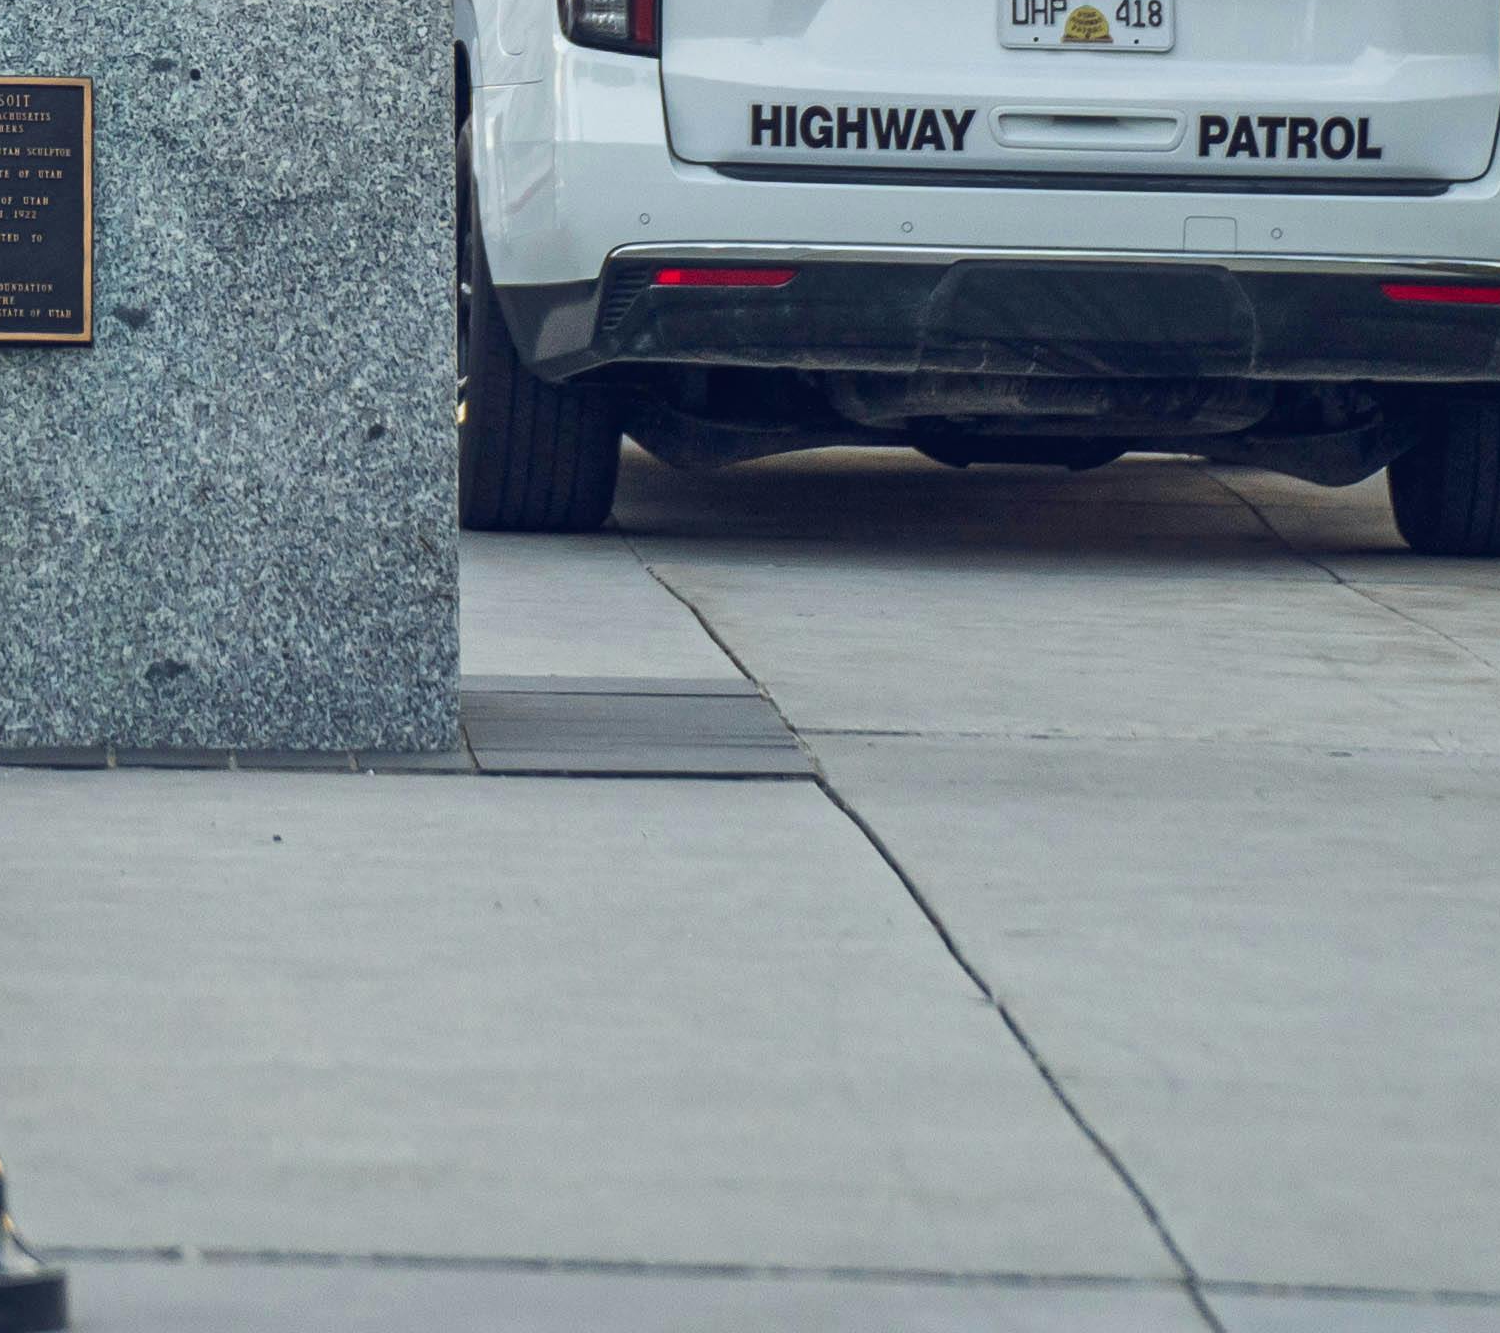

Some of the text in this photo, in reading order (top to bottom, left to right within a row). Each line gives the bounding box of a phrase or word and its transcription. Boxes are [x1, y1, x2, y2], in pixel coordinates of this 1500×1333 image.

[750, 104, 1383, 160] HIGHWAY PATROL
[27, 148, 72, 157] SCULPTOR
[19, 170, 30, 179] OF
[38, 170, 63, 179] UTAH
[1, 196, 13, 206] OF
[23, 196, 49, 206] UTAH
[14, 210, 38, 219] 1922
[31, 233, 44, 243] TO
[30, 308, 41, 318] OF
[48, 308, 72, 318] UTAH
